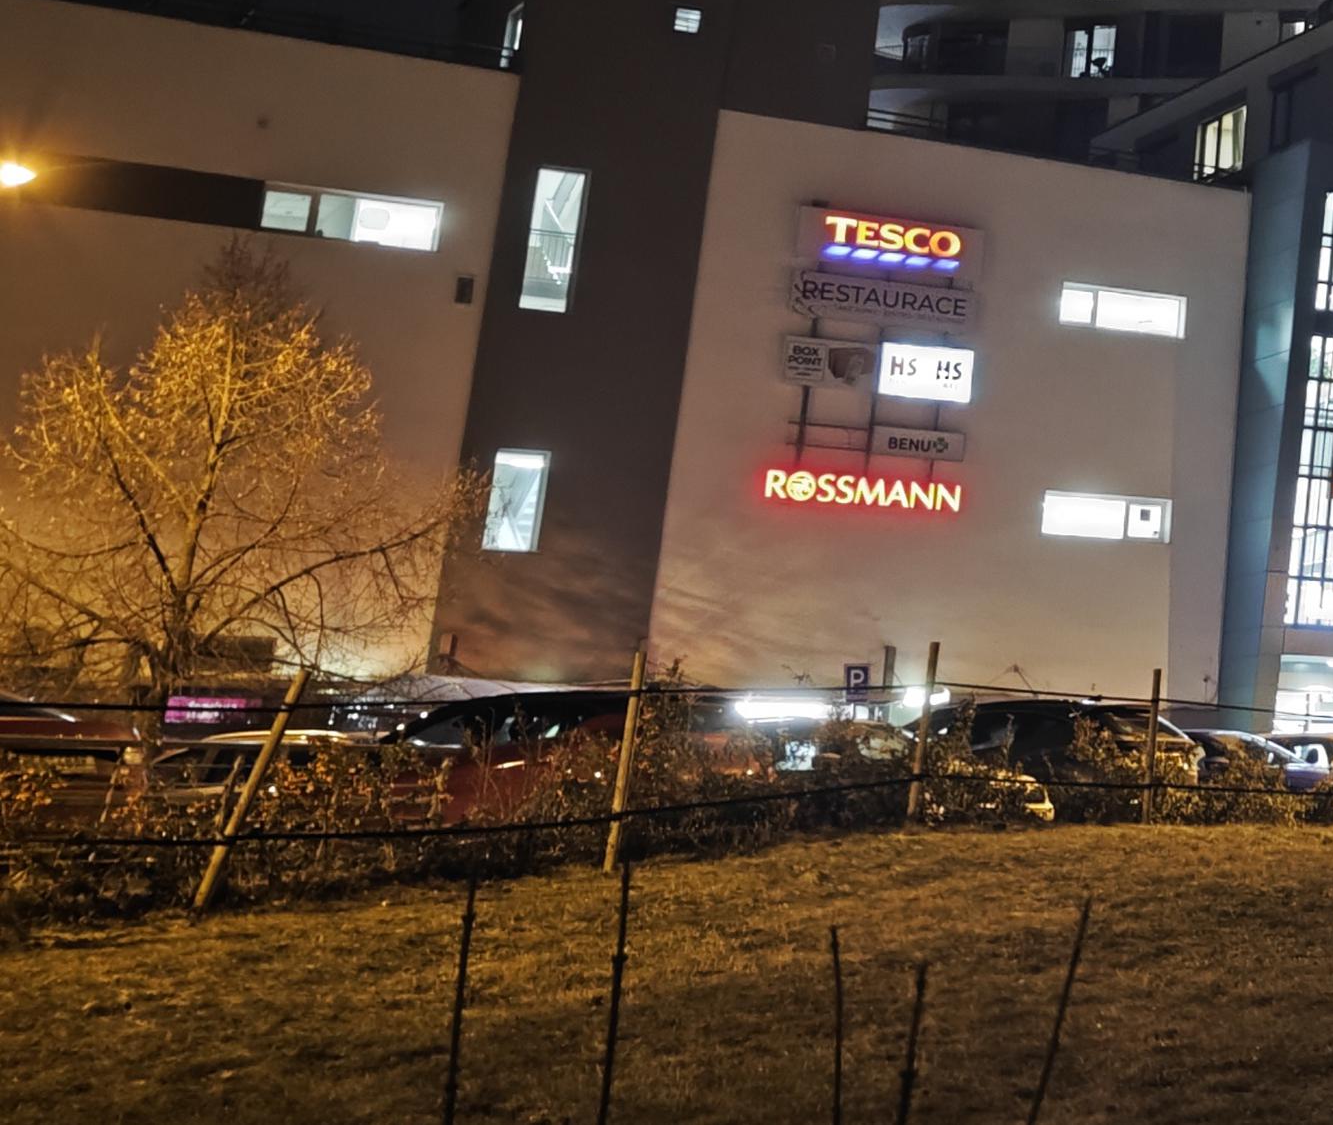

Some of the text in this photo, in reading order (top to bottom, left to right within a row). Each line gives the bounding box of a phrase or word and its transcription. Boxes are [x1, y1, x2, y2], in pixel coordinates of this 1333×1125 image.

[825, 216, 961, 257] TESCO
[802, 280, 968, 316] RESTAURACE
[788, 355, 822, 366] POINT
[793, 345, 819, 356] BOX
[890, 355, 917, 376] HS
[936, 360, 963, 380] HS
[888, 437, 931, 452] BENU
[764, 469, 961, 512] ROSSMANN
[850, 669, 865, 688] P
